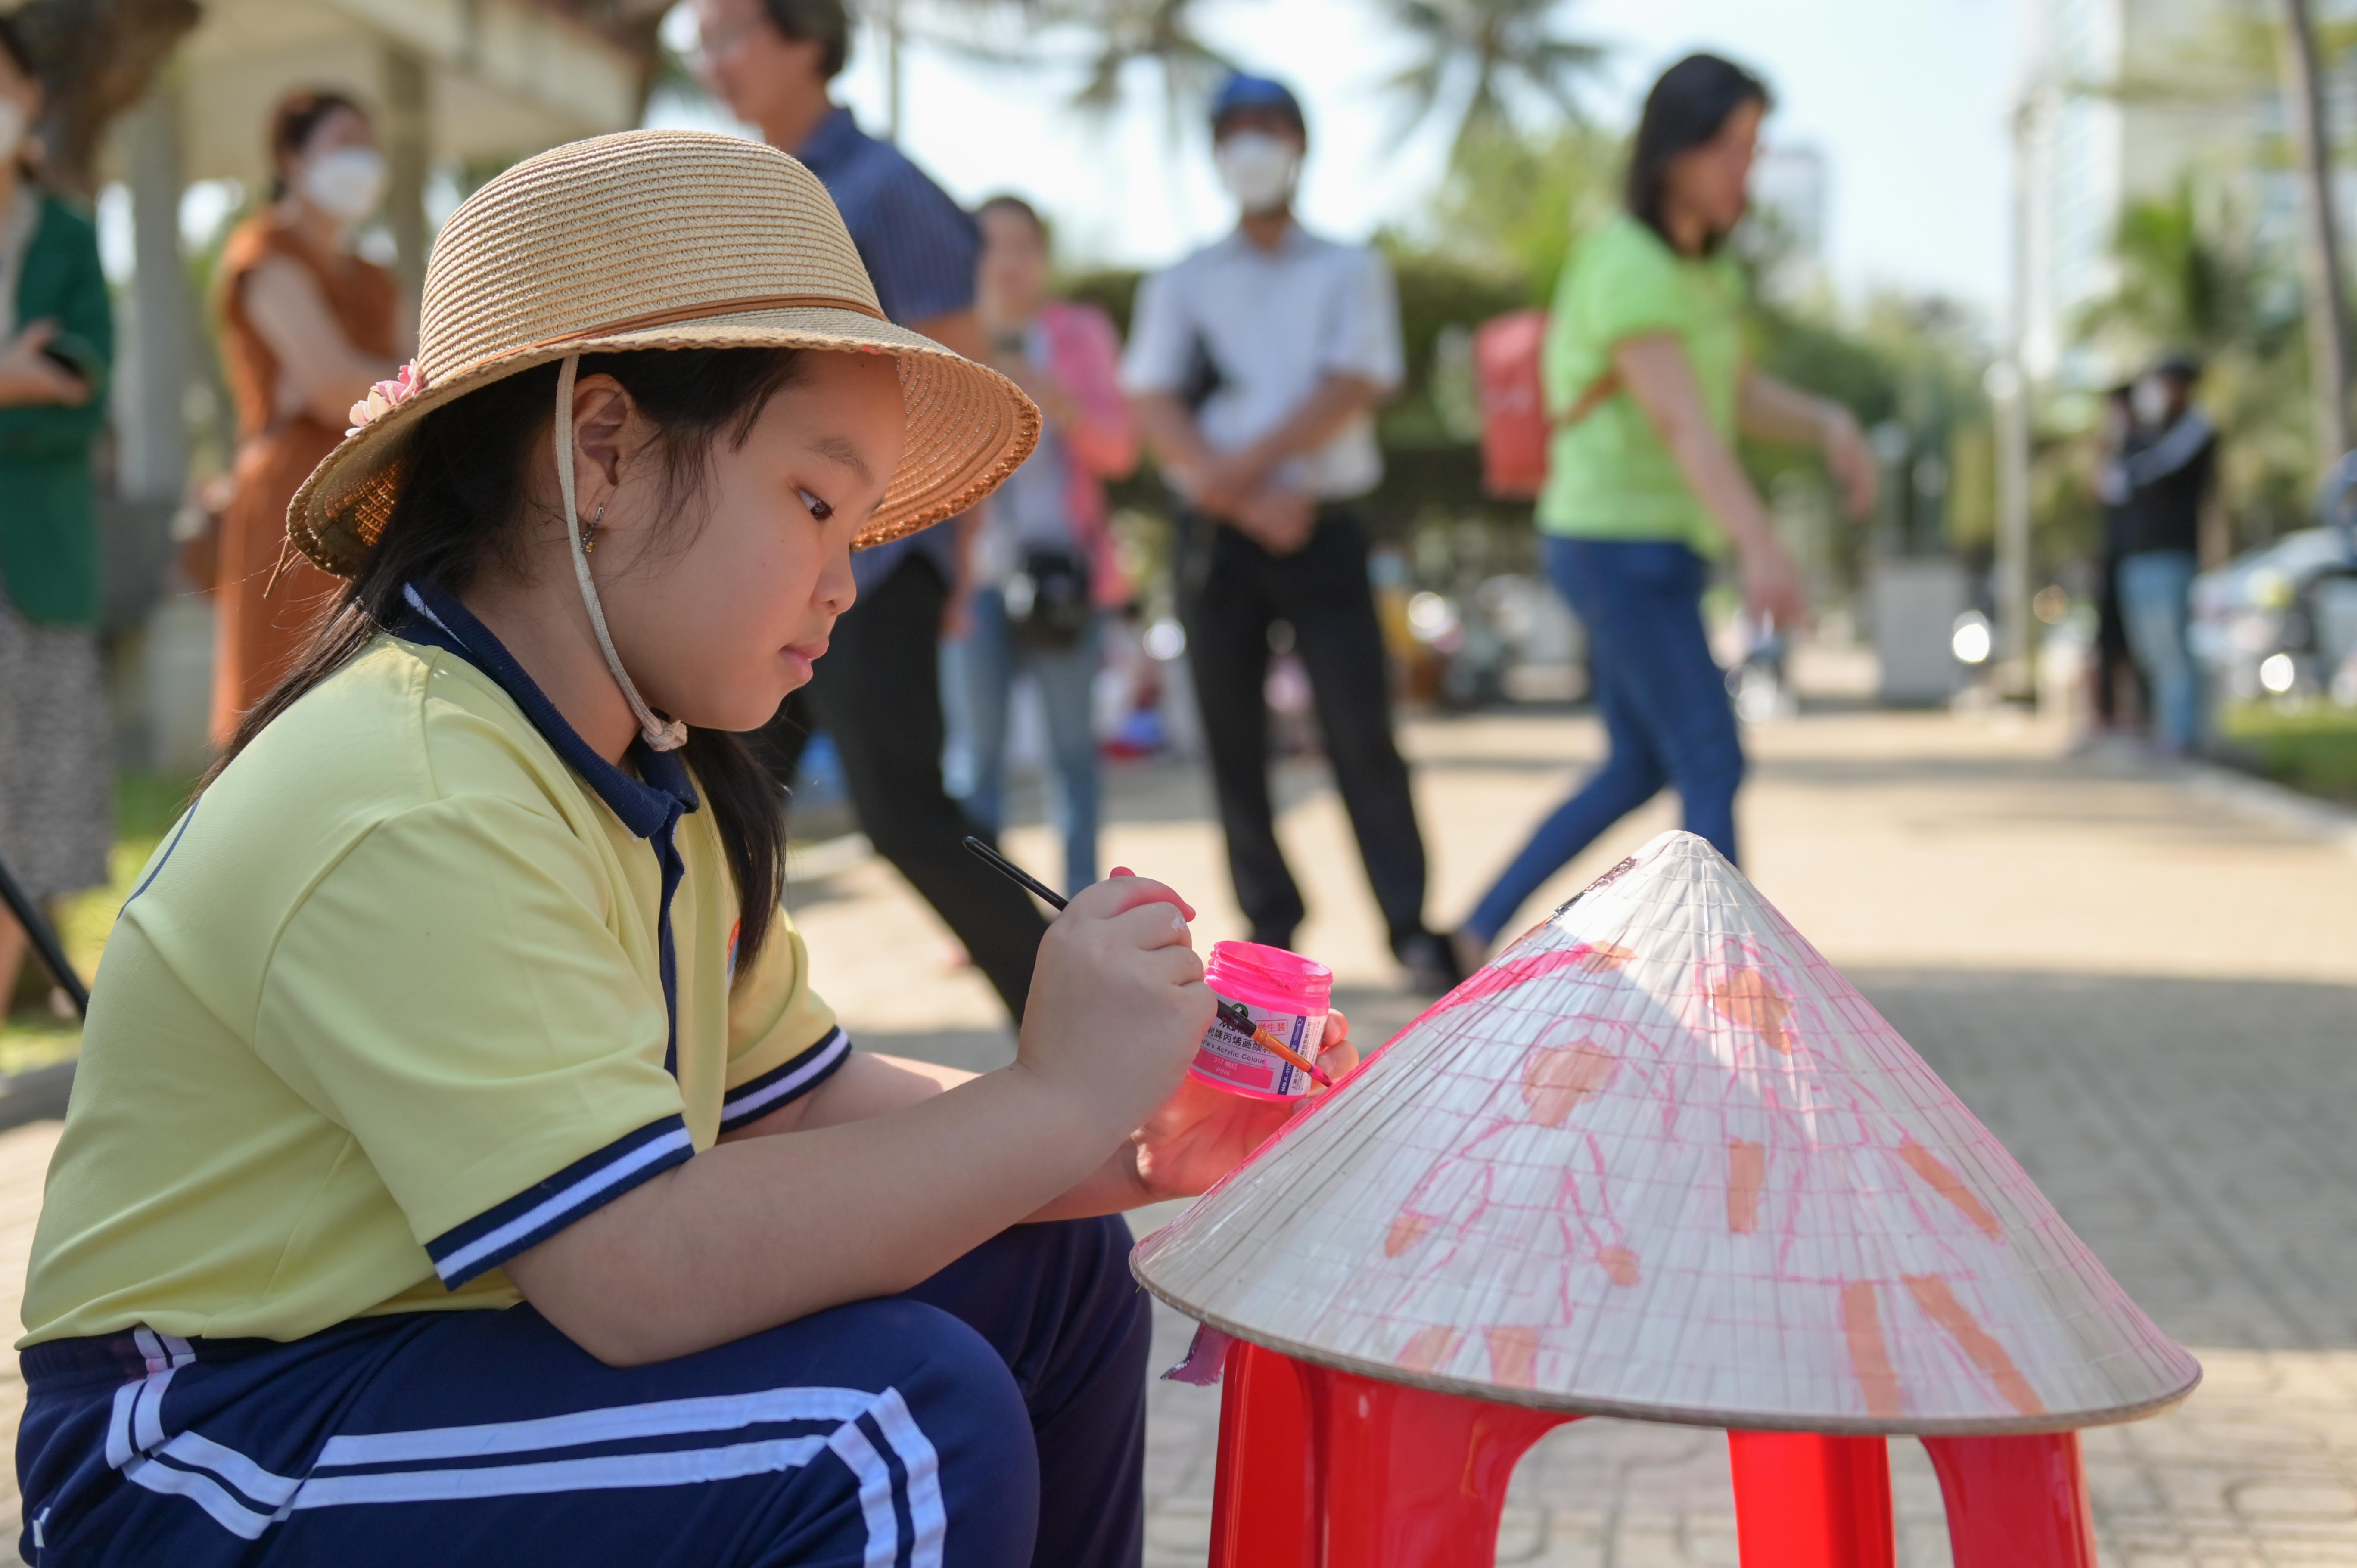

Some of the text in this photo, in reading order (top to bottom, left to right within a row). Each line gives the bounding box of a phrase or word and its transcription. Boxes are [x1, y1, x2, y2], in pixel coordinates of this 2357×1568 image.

[1257, 1022, 1285, 1032] 学生装
[1207, 1026, 1271, 1054] 利牌丙烯画颜
[1216, 1045, 1239, 1057] Acrylic
[1241, 1053, 1265, 1064] Colour
[1213, 1056, 1224, 1065] 317
[1216, 1067, 1231, 1076] PINK
